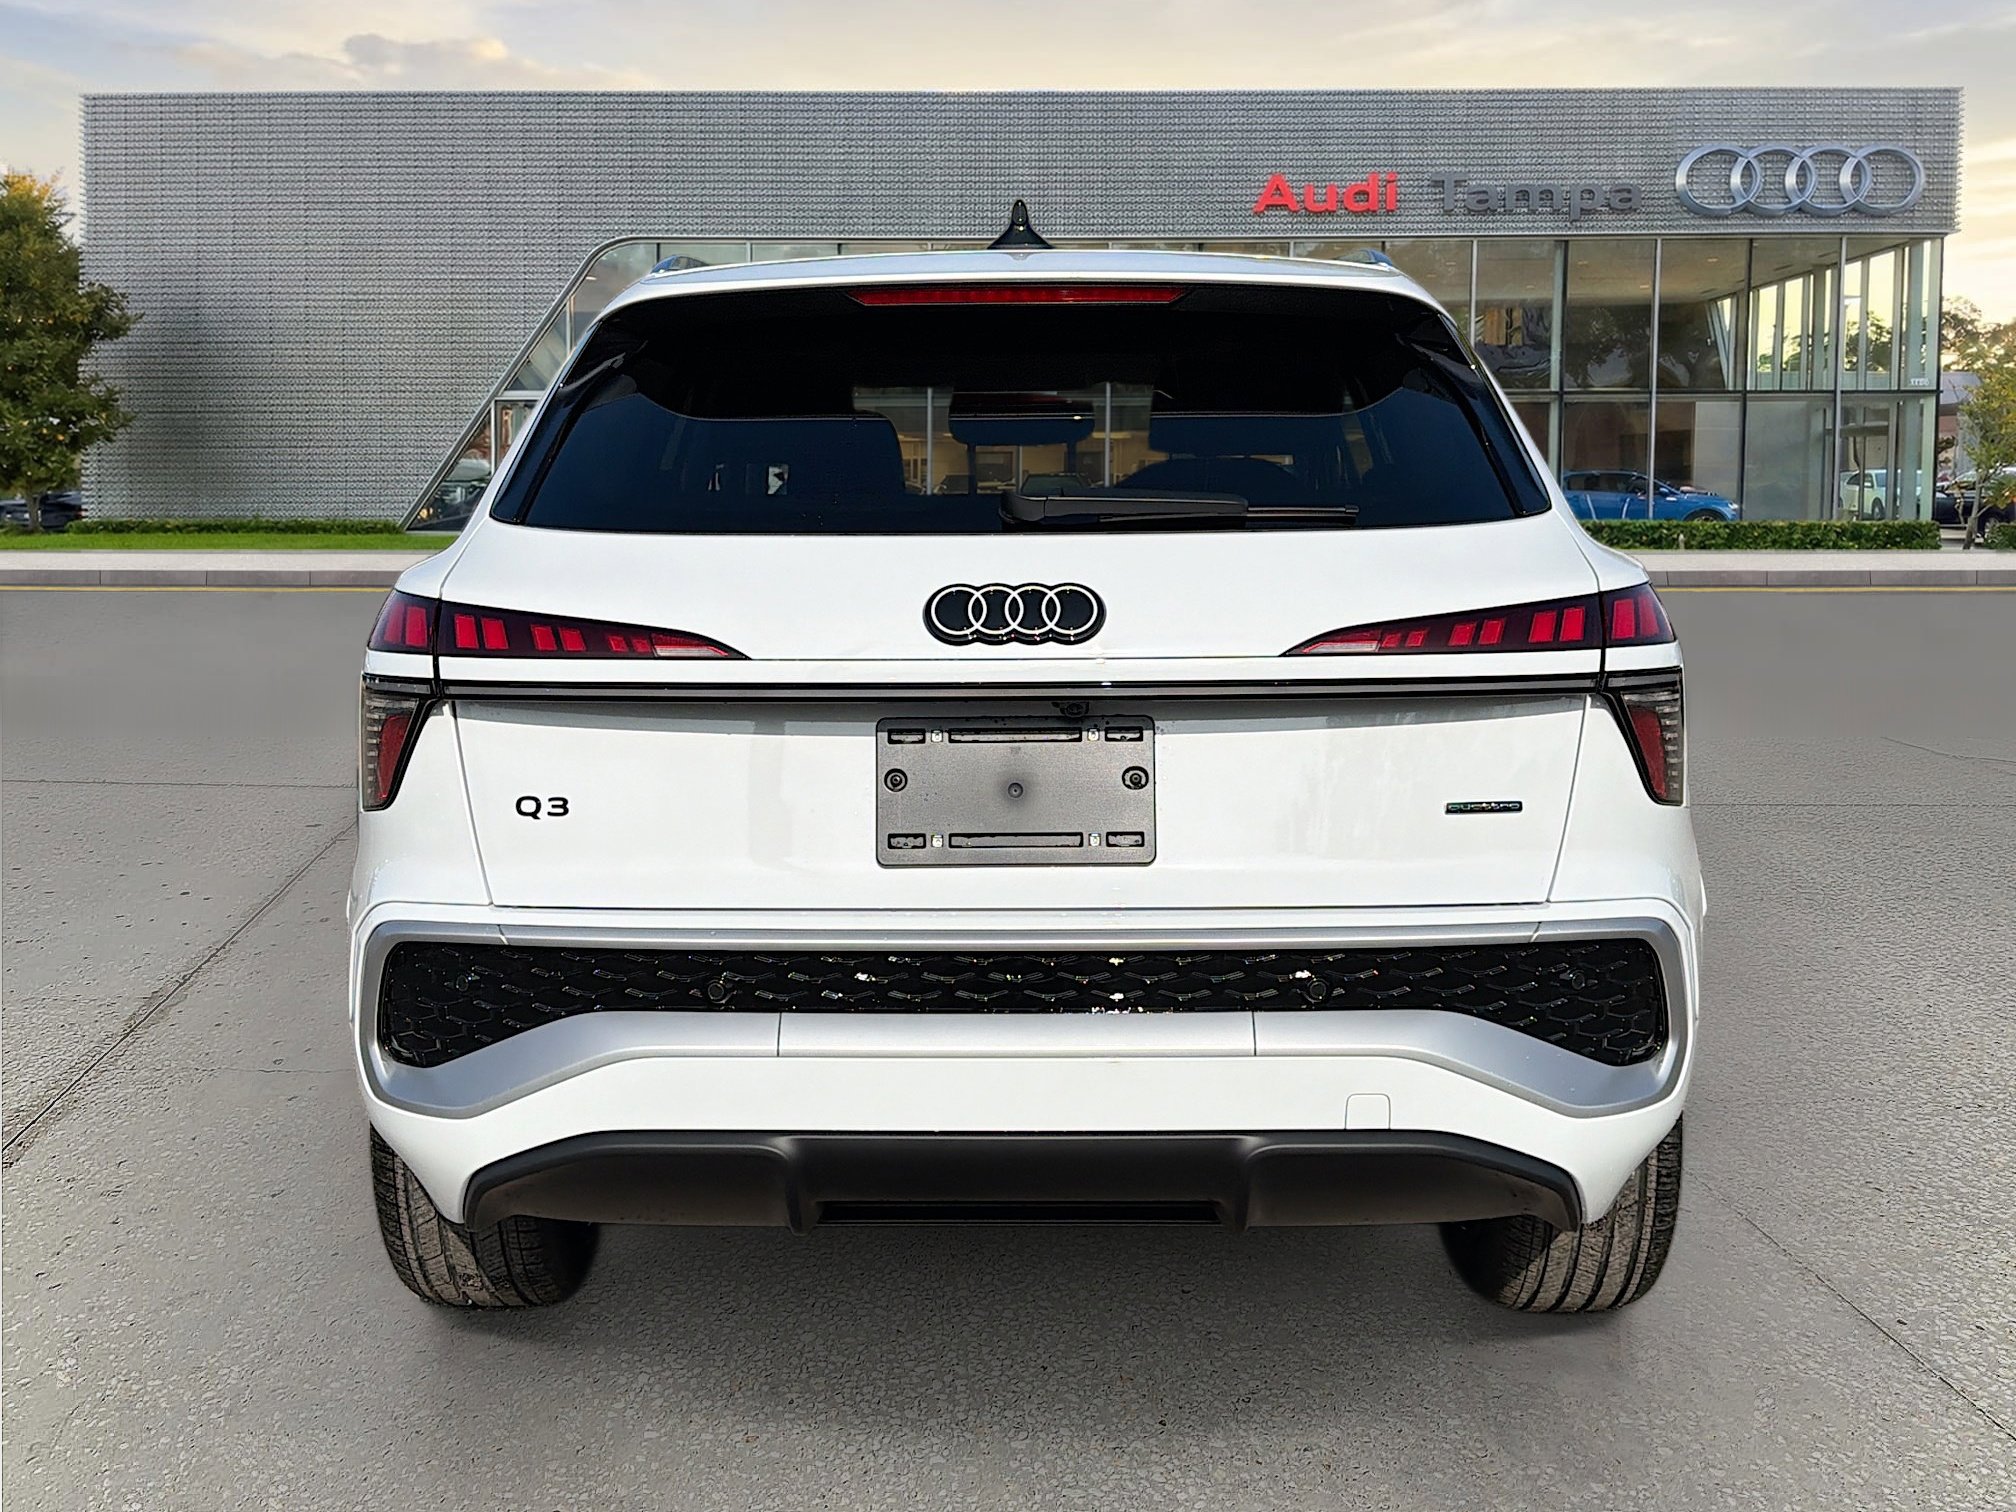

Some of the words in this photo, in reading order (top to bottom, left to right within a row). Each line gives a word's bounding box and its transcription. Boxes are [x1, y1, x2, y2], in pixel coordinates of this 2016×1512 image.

[1252, 171, 1398, 214] Audi
[1430, 171, 1643, 222] Tampa
[515, 795, 569, 820] Q3
